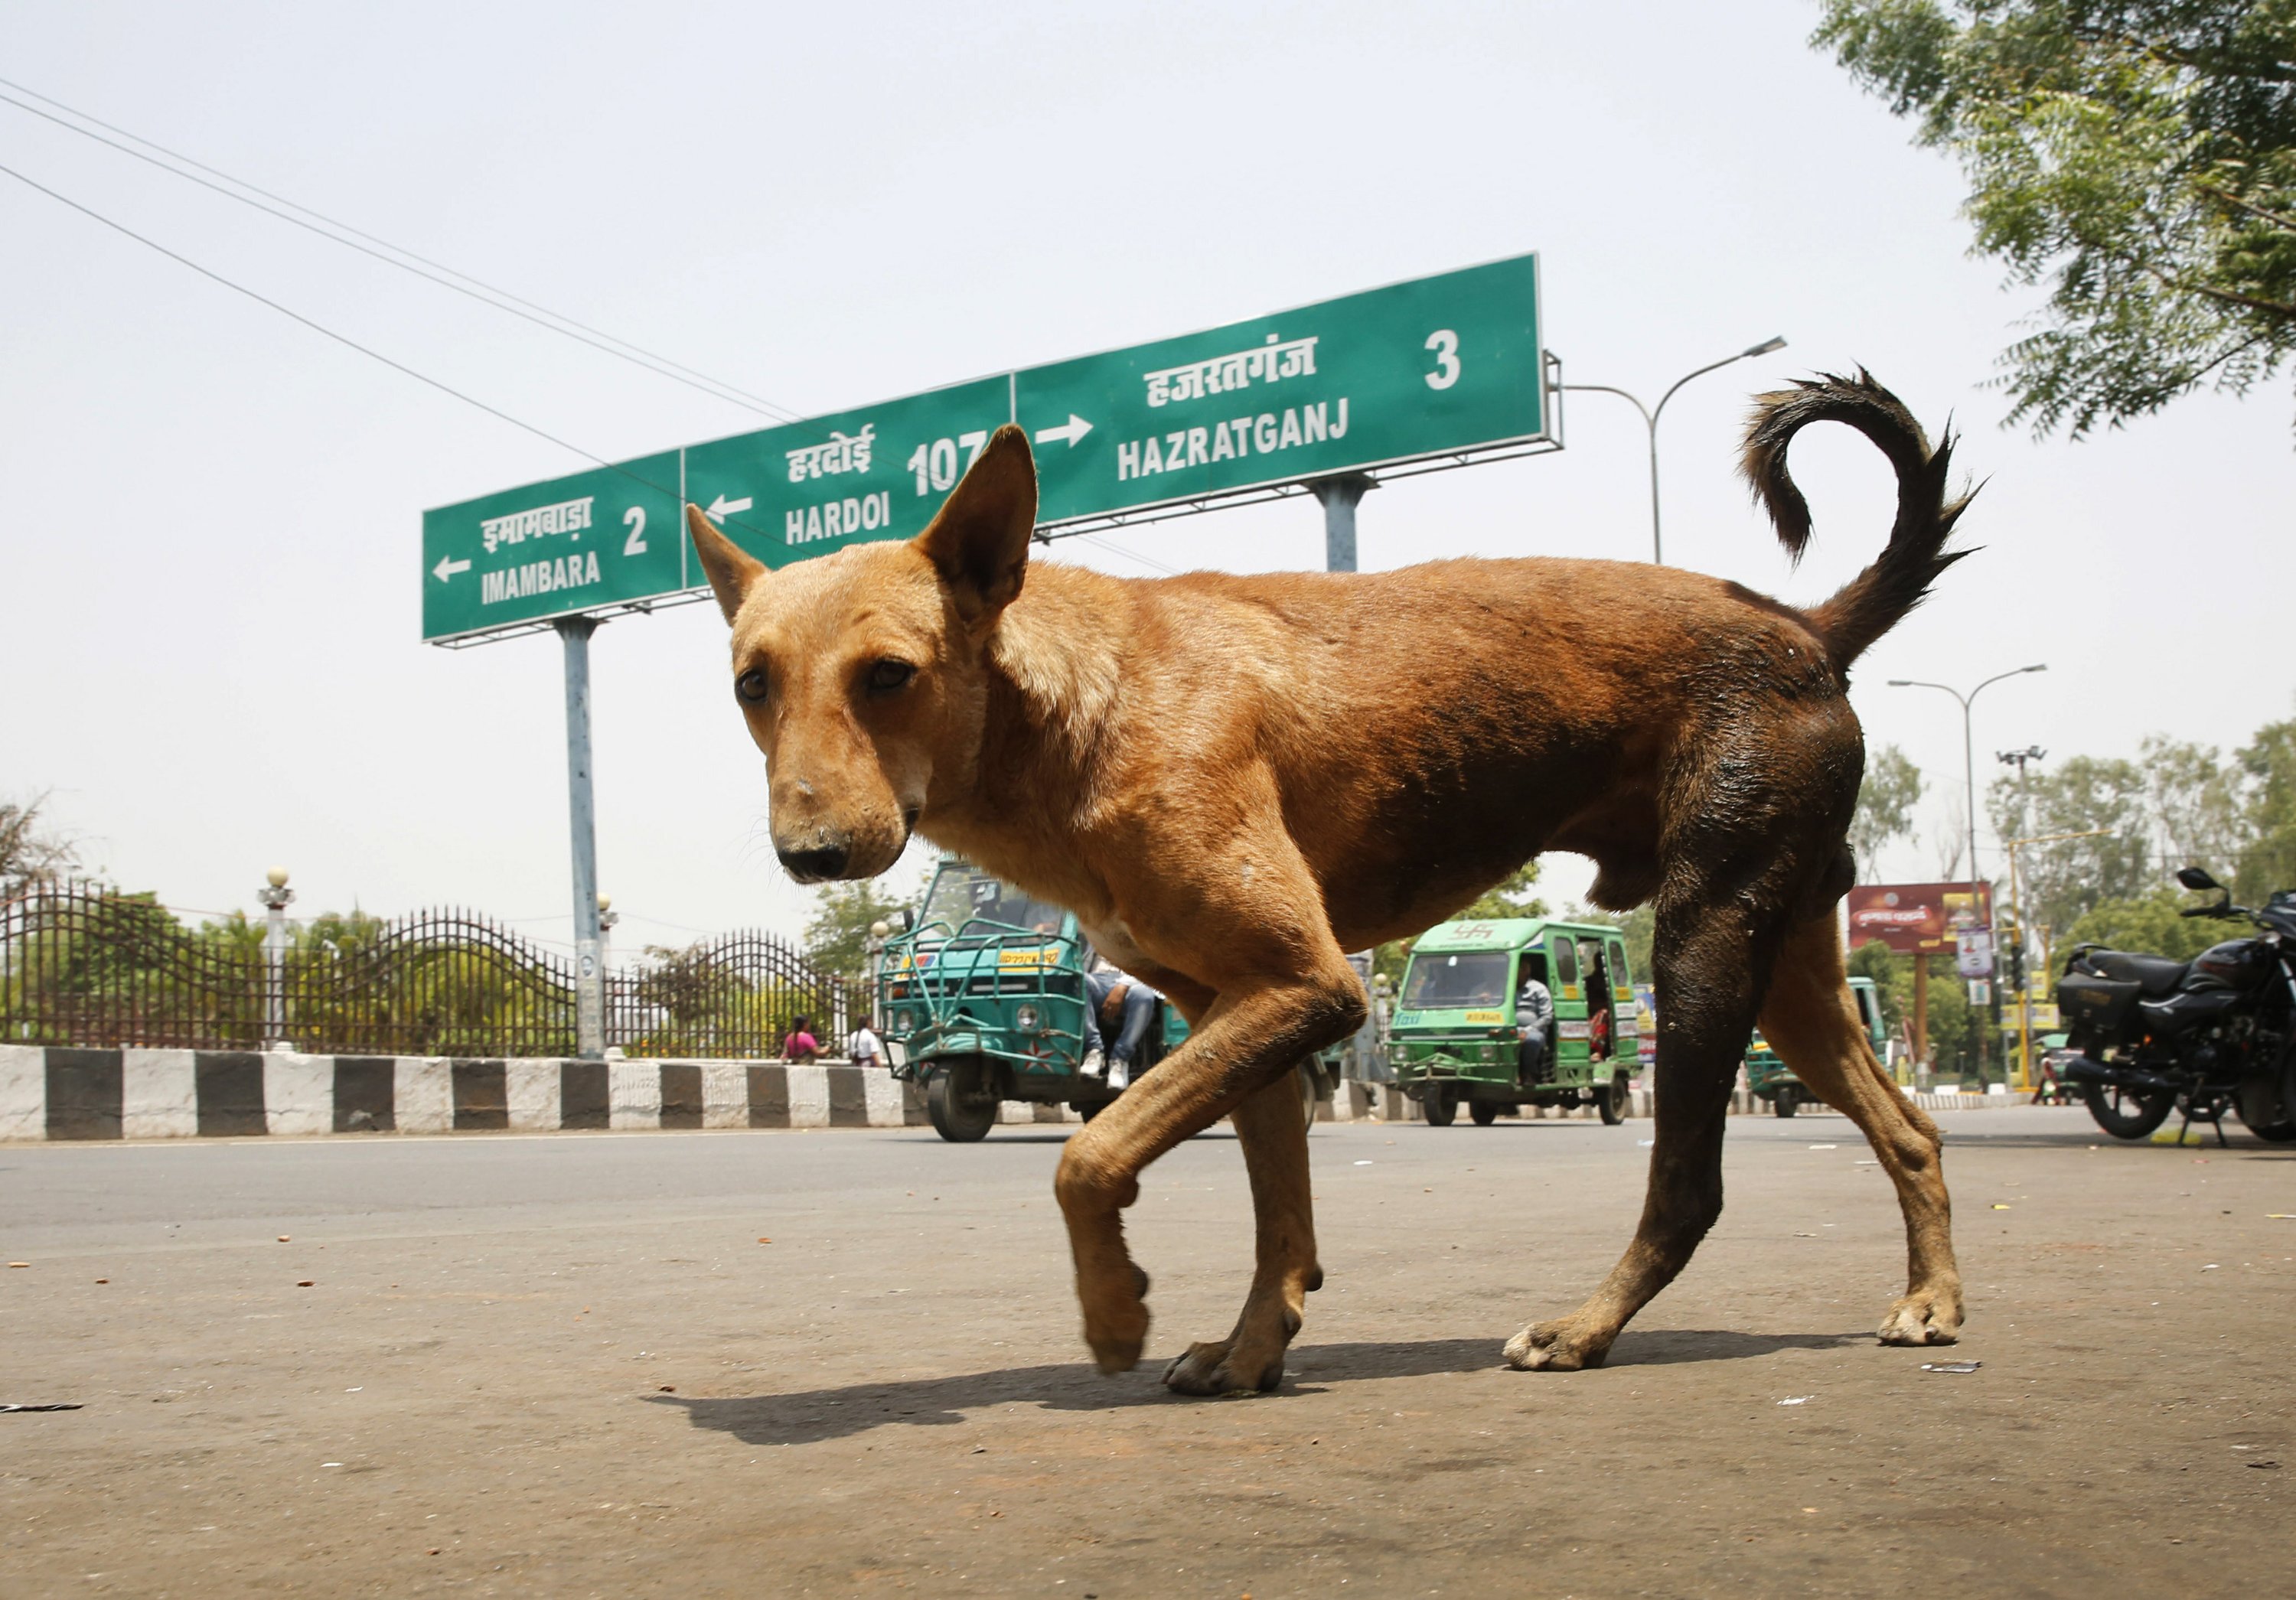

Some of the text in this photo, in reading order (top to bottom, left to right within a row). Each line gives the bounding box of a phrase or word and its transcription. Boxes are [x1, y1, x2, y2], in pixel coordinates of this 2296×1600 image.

[1143, 333, 1319, 408] हजरतगंज
[1424, 329, 1461, 391] 3
[785, 422, 876, 483] हरदोई
[908, 430, 987, 497] 107
[1118, 398, 1349, 482] HAZRATGANJ
[480, 496, 594, 554] इमामबाड़ा
[623, 506, 647, 556] 2
[785, 490, 890, 546] HARDOI
[481, 551, 601, 605] IMAMBARA
